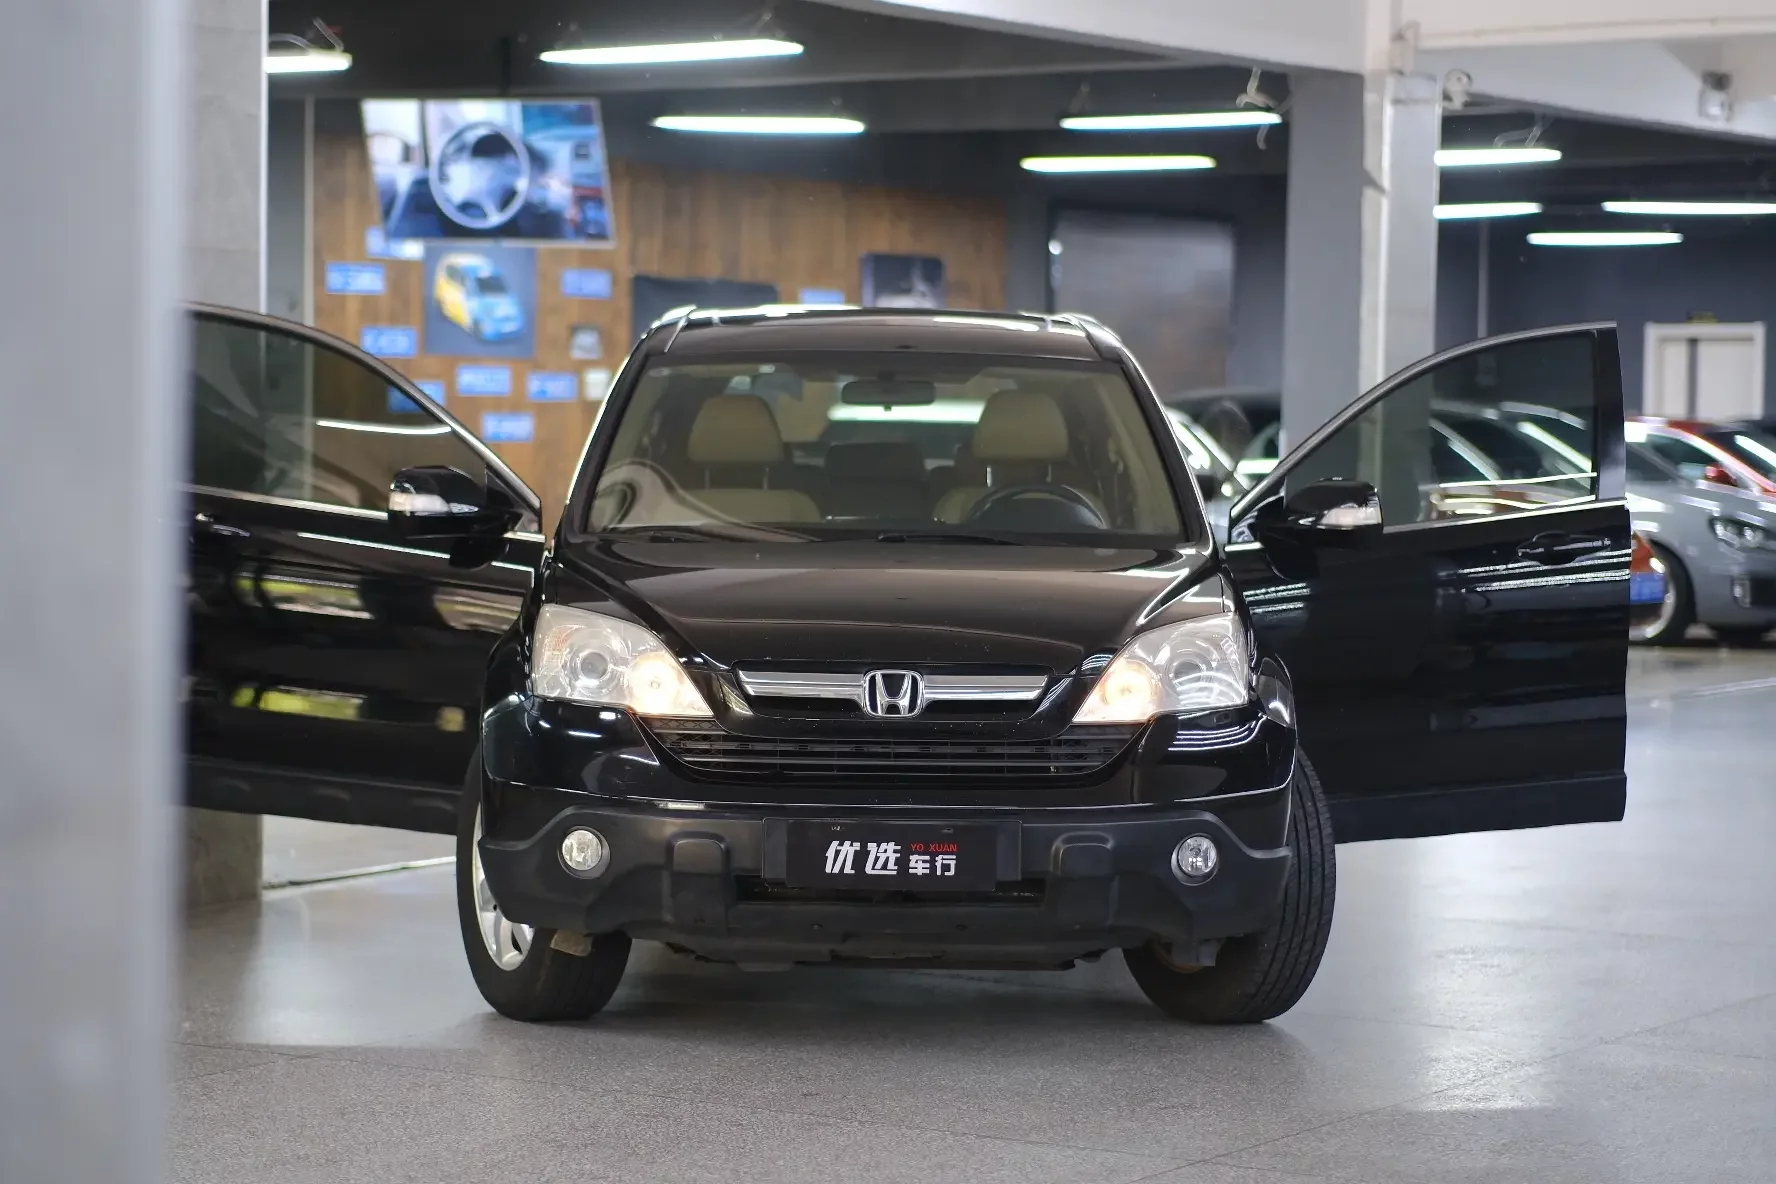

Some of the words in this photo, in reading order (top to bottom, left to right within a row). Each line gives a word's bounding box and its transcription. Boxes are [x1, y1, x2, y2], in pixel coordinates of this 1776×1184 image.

[825, 840, 901, 875] 优选
[910, 843, 924, 852] YO
[929, 843, 957, 852] XUAN
[908, 854, 957, 876] 车行
